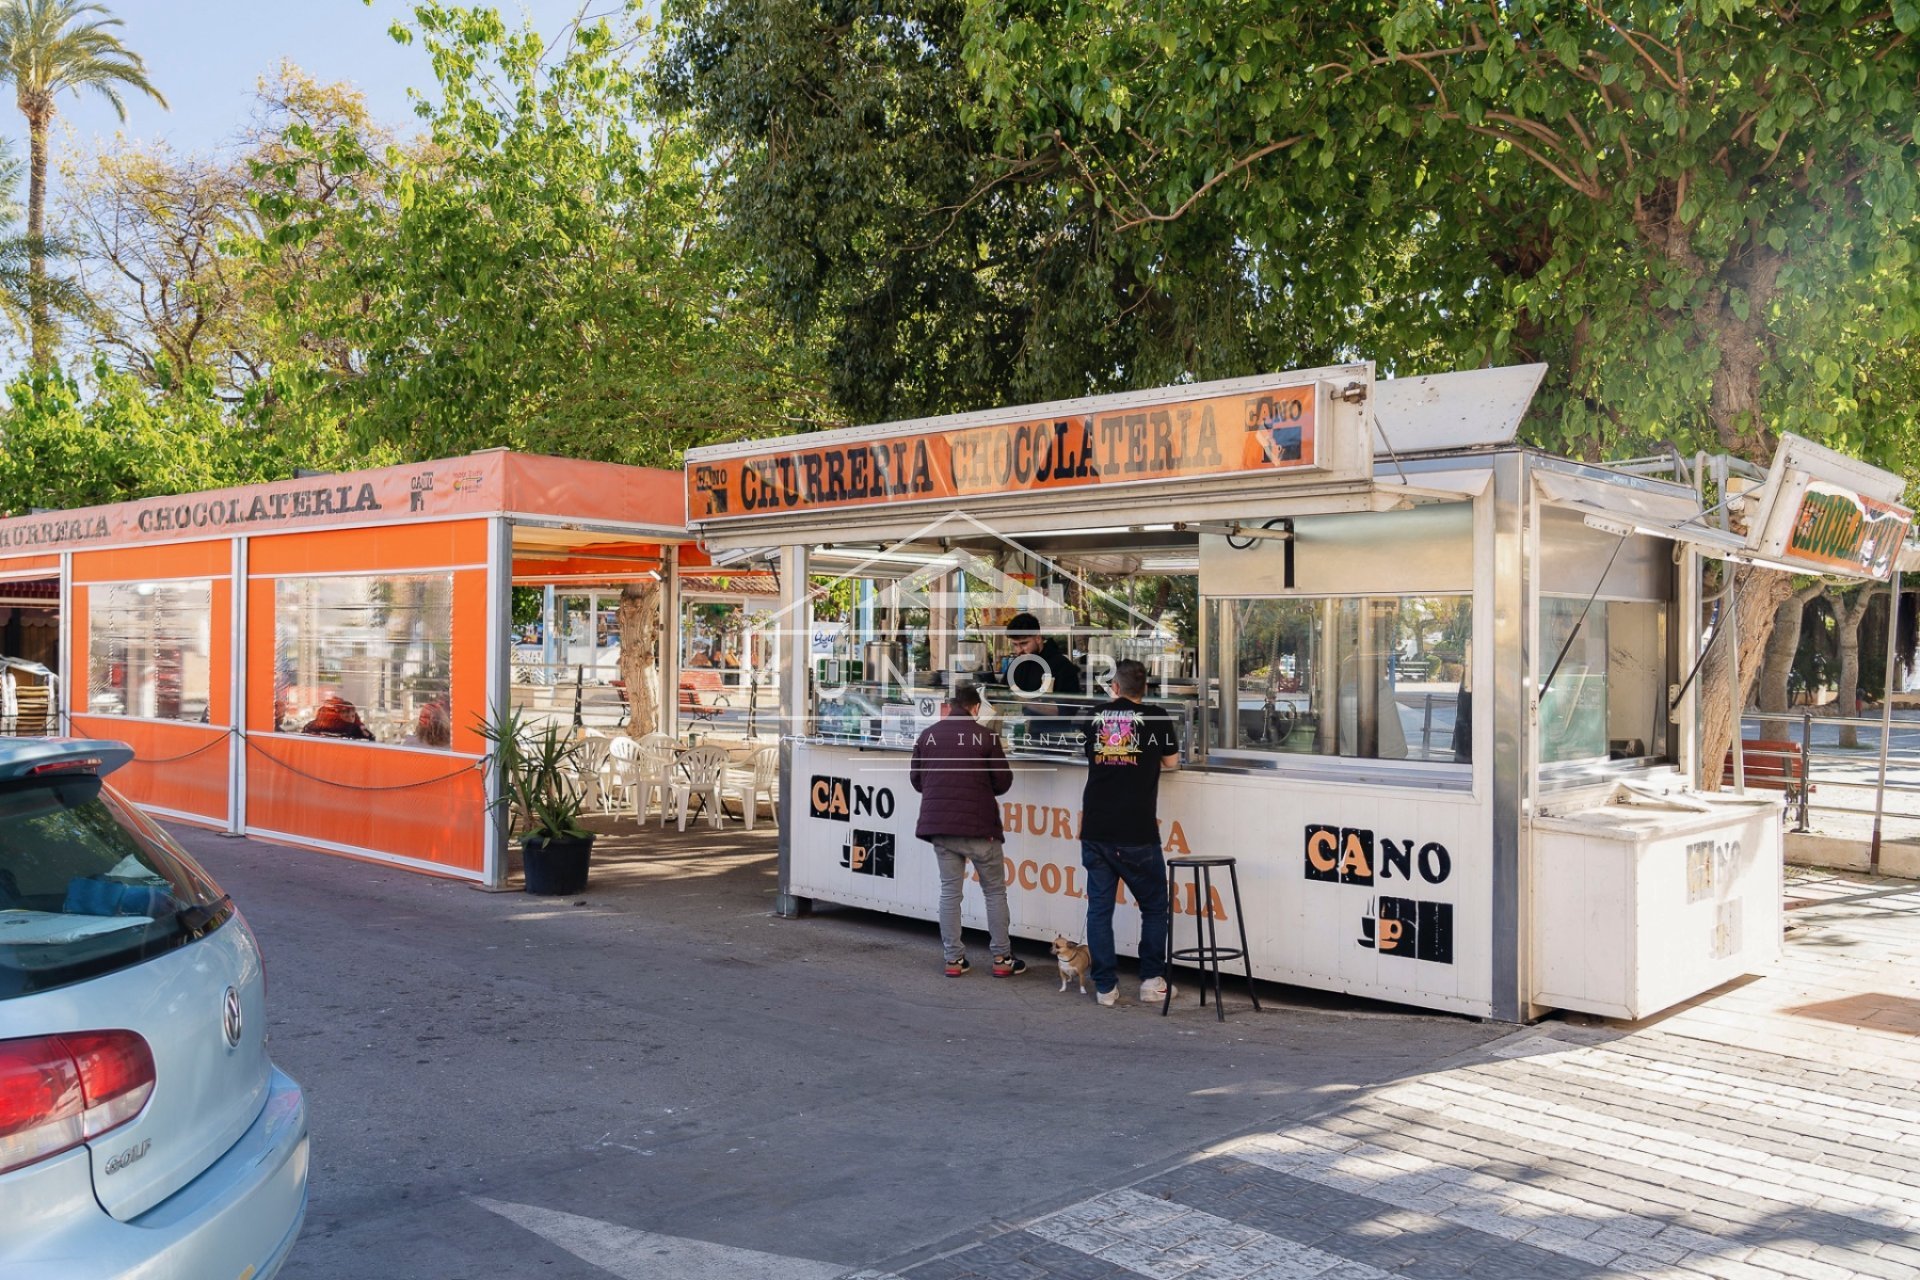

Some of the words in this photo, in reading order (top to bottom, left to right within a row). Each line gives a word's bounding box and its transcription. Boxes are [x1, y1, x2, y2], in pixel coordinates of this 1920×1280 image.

[740, 438, 934, 511] CHURRERIA
[951, 405, 1222, 488] CHOCOLATERIA
[138, 482, 382, 533] CHOCOLATERIA
[812, 779, 895, 819] CANO
[1308, 830, 1451, 884] CANO
[105, 1137, 152, 1176] GOLF
